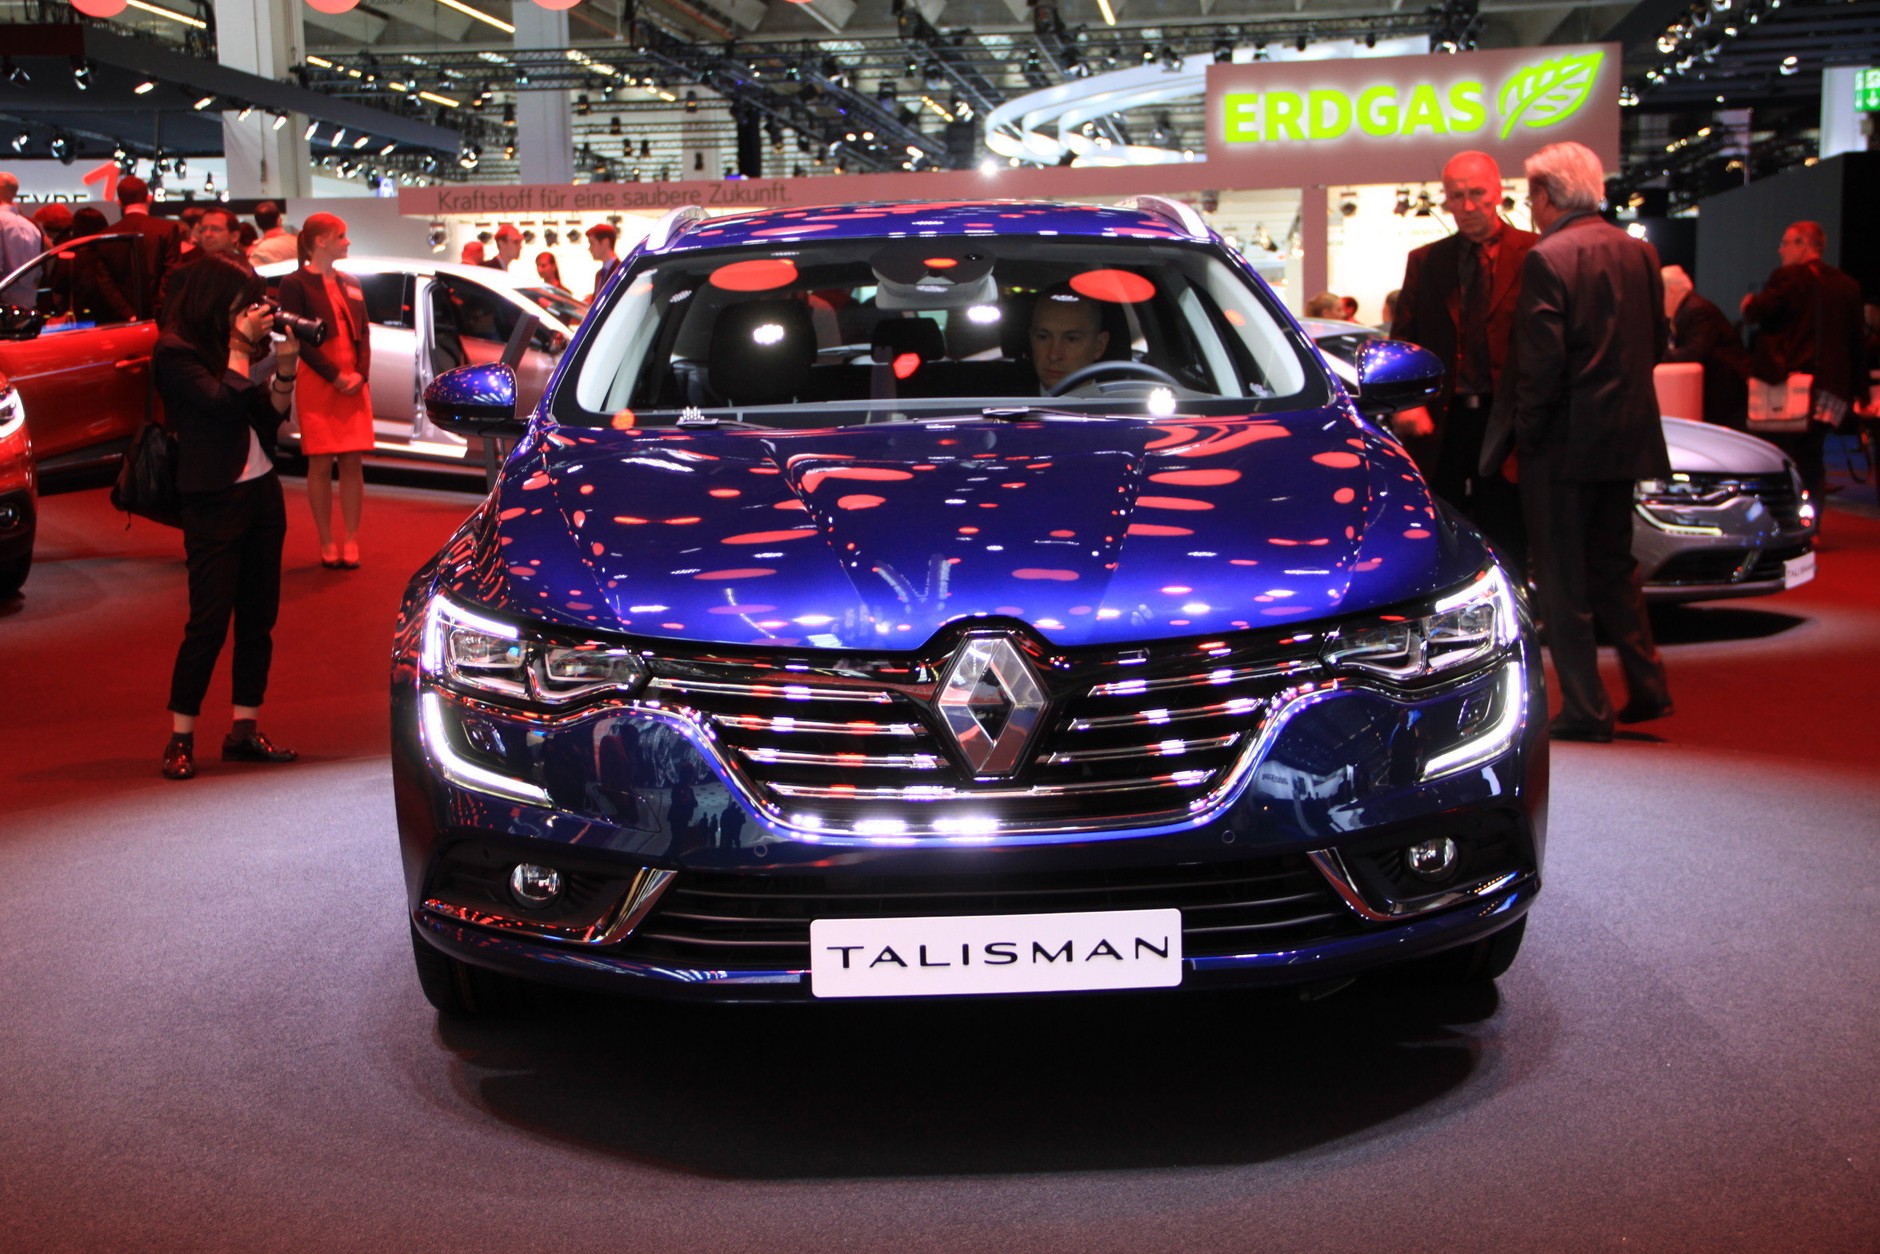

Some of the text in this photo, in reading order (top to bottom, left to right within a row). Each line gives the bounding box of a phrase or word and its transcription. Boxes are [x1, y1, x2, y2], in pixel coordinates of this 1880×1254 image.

[1223, 81, 1487, 143] ERDGAS
[438, 181, 792, 211] Kraftstoff für eine saubere Zukunft.
[826, 936, 1169, 969] TALISMAN
